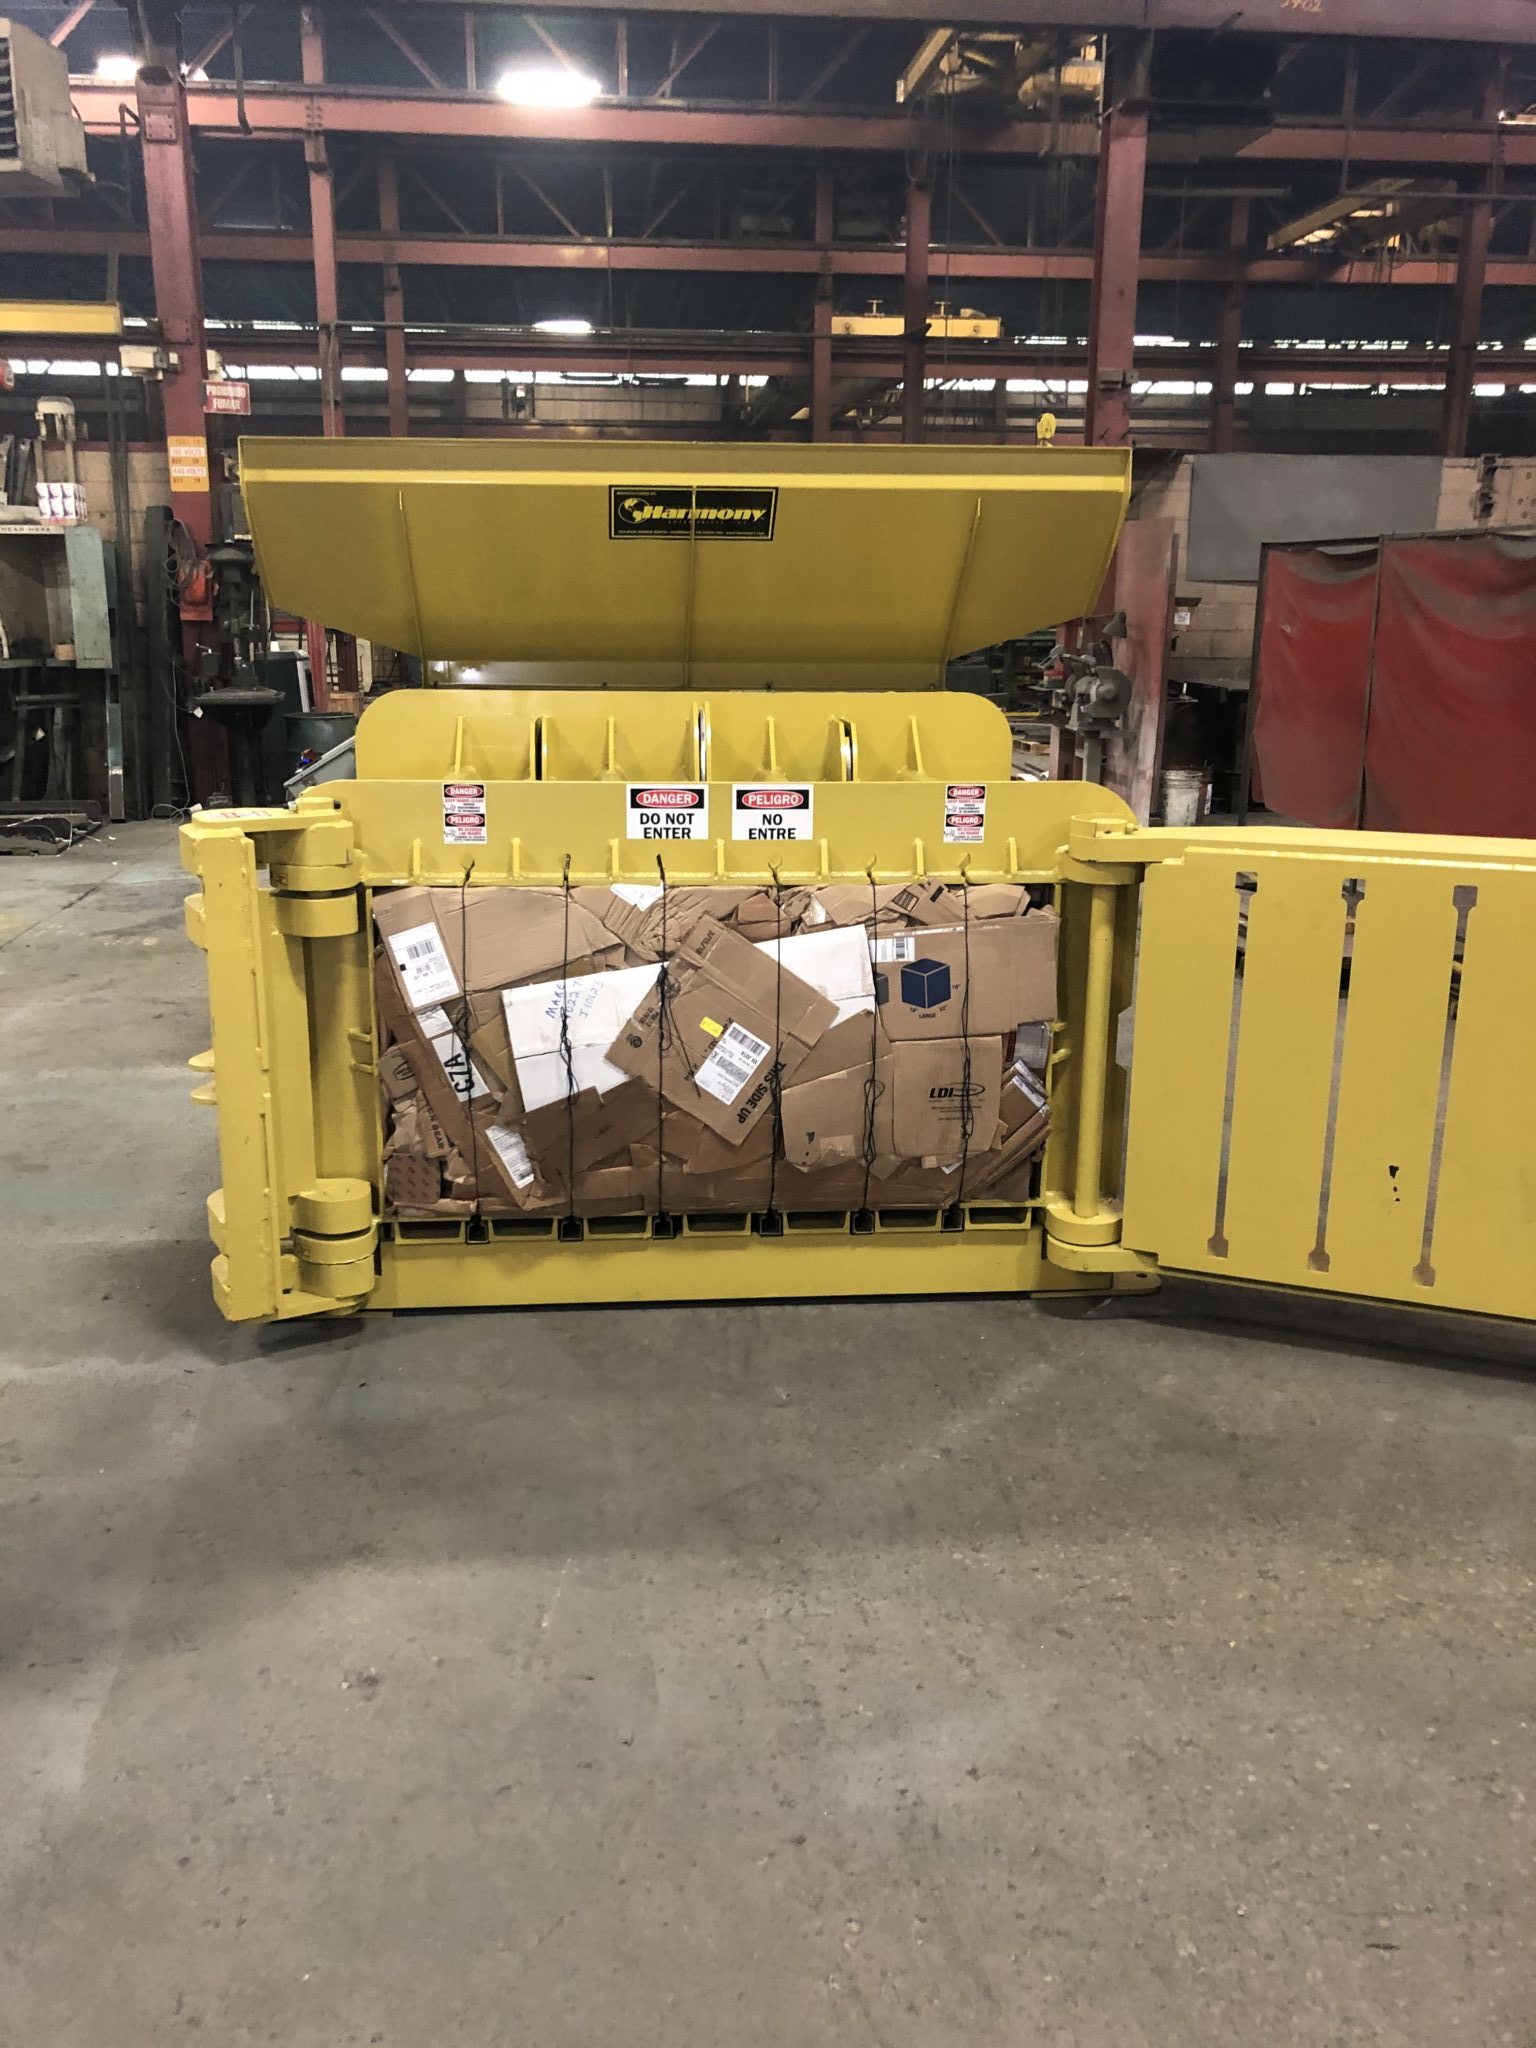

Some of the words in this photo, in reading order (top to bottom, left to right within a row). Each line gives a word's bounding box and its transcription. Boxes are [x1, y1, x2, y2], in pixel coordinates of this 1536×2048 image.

[642, 506, 767, 522] Harmony
[643, 793, 693, 805] DANGER
[748, 794, 799, 805] PELIGRO
[640, 813, 660, 825] DO
[665, 813, 695, 825] NOT
[762, 814, 783, 826] NO
[643, 827, 692, 839] ENTER
[748, 828, 797, 840] ENTRE
[746, 1083, 769, 1109] SIDE
[929, 1087, 955, 1099] LDI
[737, 1107, 752, 1124] UP
